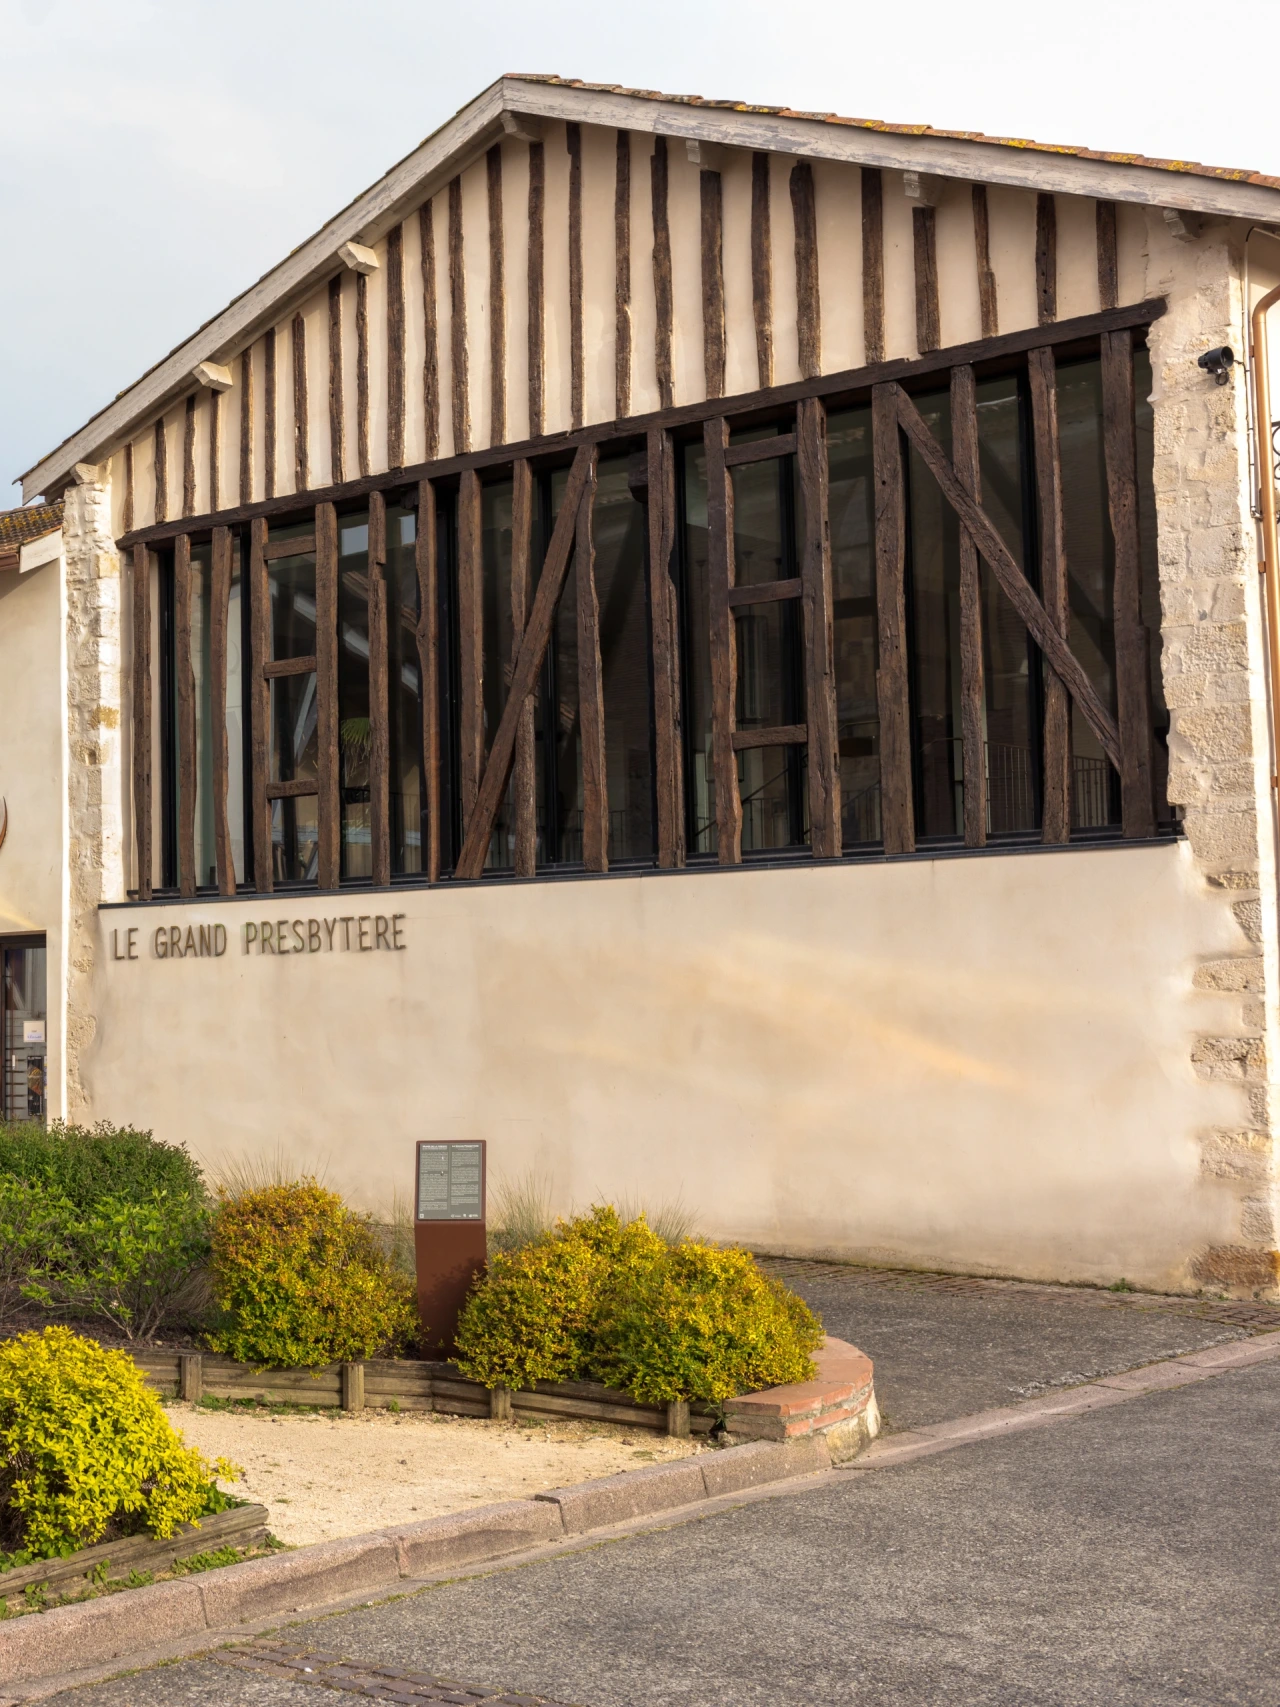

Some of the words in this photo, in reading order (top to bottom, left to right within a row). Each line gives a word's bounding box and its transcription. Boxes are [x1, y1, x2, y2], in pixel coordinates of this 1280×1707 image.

[114, 928, 138, 960] LE
[155, 923, 227, 959] GRAND
[245, 914, 407, 955] PRESBYTERE
